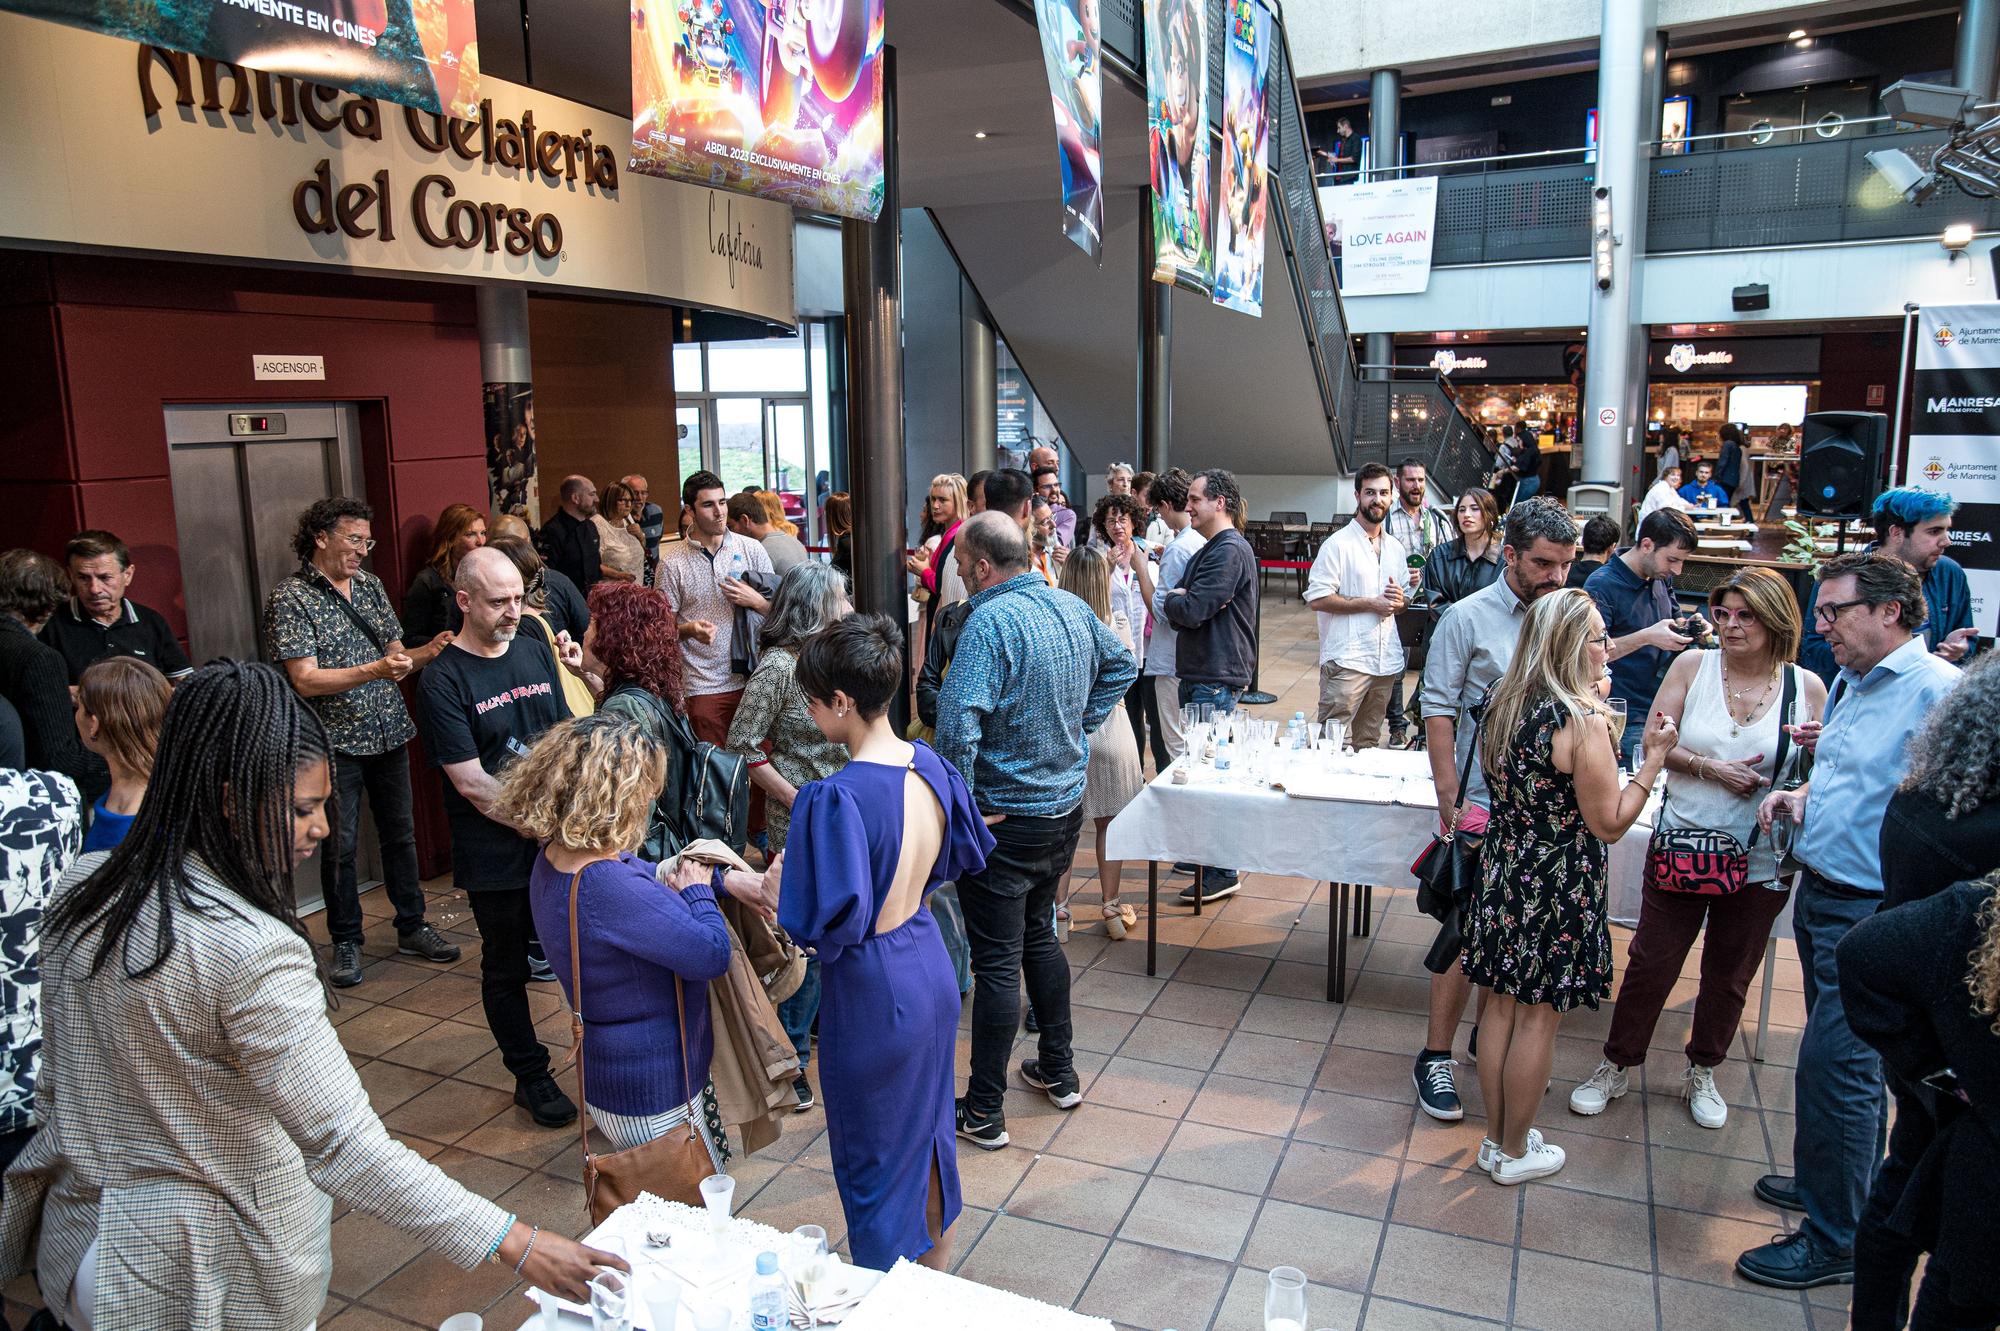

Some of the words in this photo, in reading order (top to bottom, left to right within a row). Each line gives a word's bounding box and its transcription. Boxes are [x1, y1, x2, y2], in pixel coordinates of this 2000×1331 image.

[306, 11, 330, 32] EN
[332, 19, 377, 46] CINES
[704, 140, 729, 158] ABRIL
[730, 147, 749, 161] 2023
[750, 152, 812, 178] EXCLUSIVAMENTE
[812, 168, 822, 180] EN
[822, 172, 841, 184] CINES
[293, 158, 396, 241] del
[412, 174, 563, 258] Corso
[1350, 233, 1382, 246] LOVE
[1385, 230, 1427, 243] AGAIN
[262, 362, 317, 373] ASCENSOR
[1947, 463, 1997, 471] Ajuntament
[511, 682, 552, 700] BERGMAN
